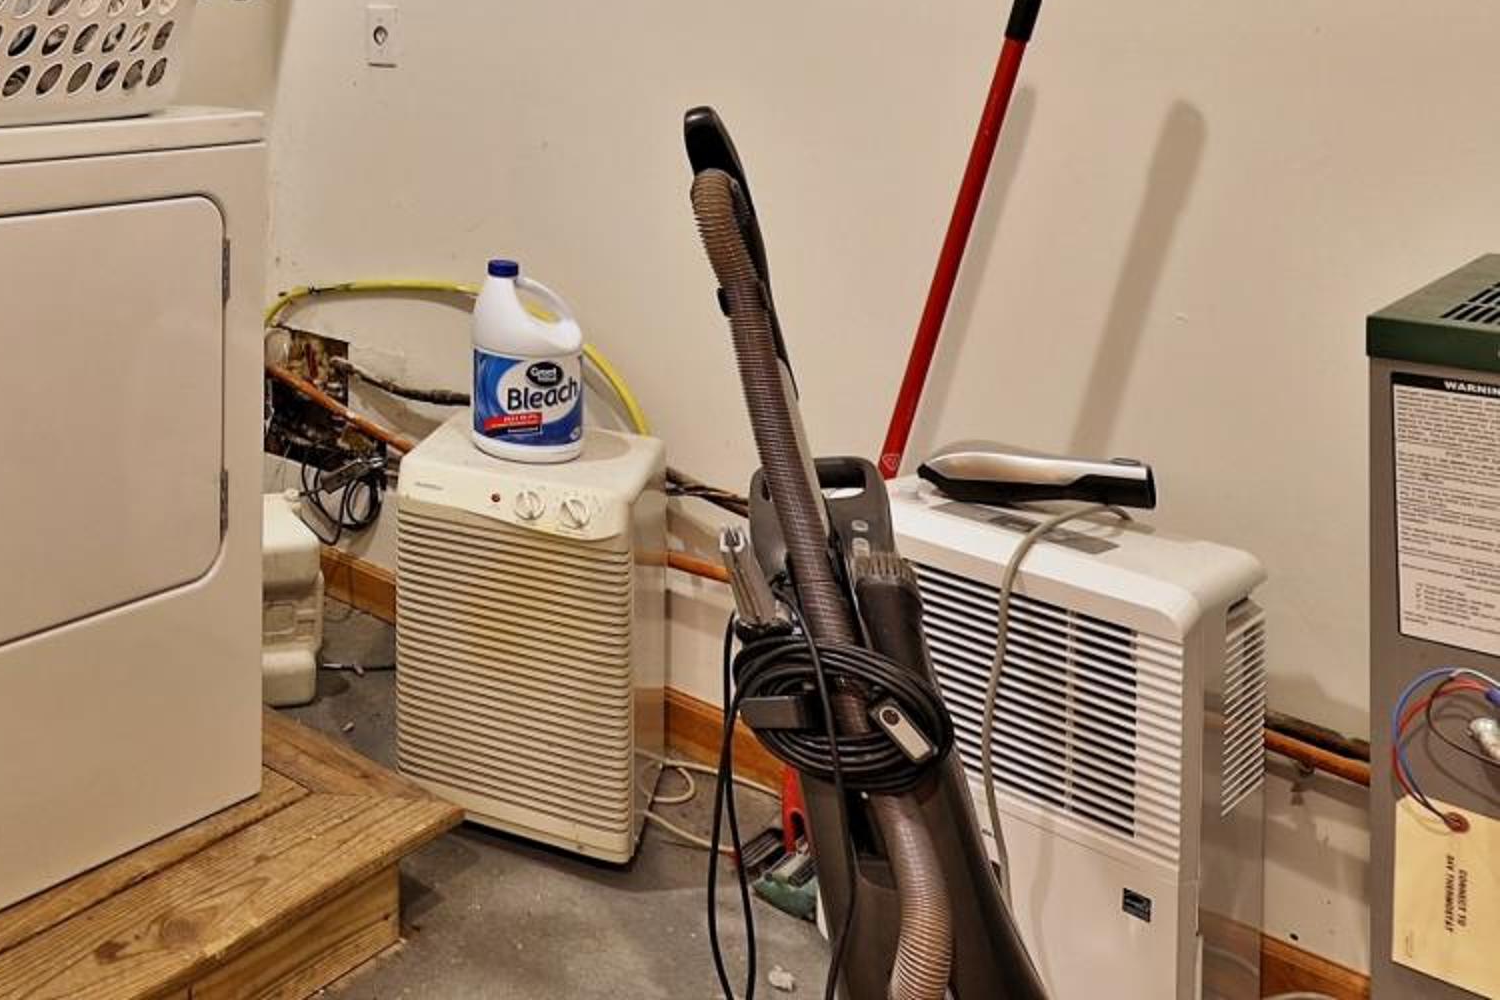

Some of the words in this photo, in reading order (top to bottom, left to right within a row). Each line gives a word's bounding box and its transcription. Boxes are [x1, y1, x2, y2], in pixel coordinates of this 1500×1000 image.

[507, 376, 578, 411] Bleach
[1444, 873, 1455, 933] THERMOSTAT
[1457, 868, 1469, 912] CONNECT
